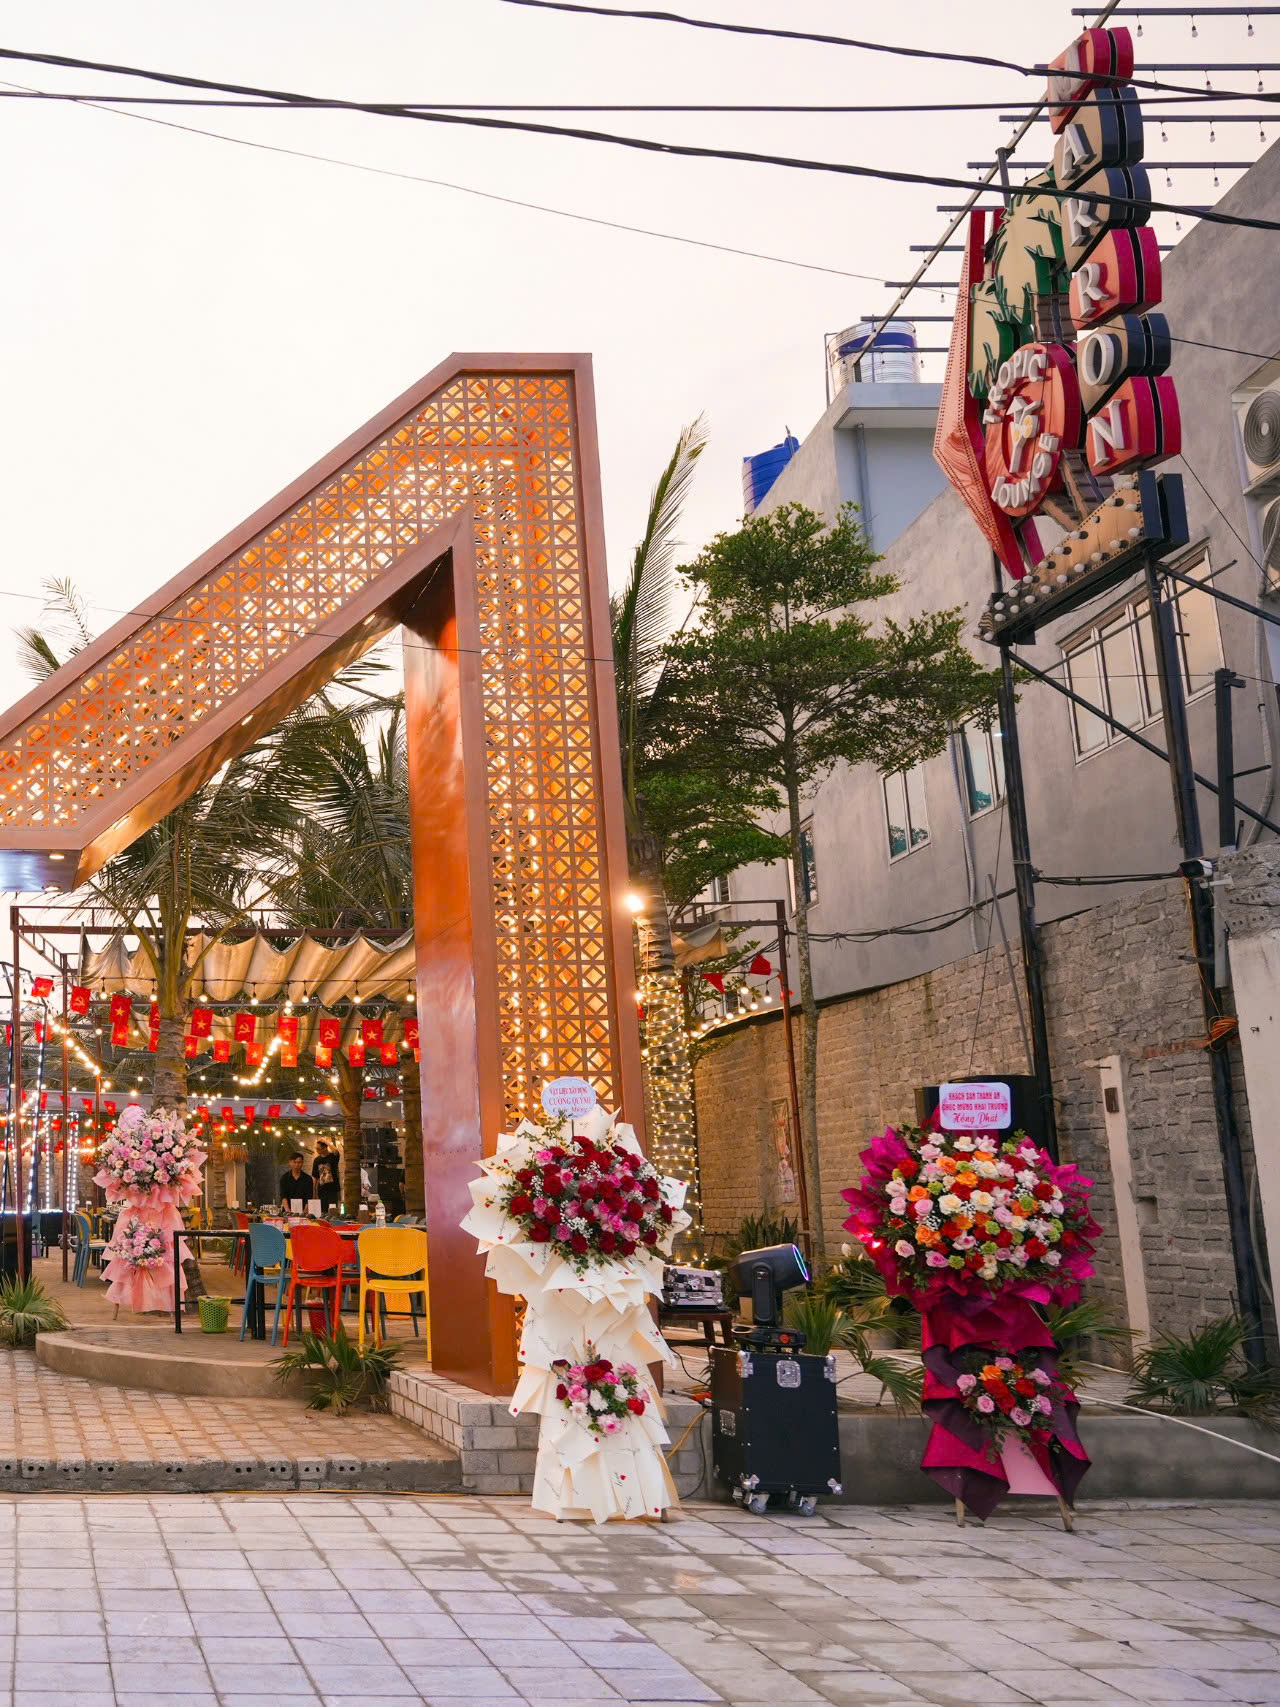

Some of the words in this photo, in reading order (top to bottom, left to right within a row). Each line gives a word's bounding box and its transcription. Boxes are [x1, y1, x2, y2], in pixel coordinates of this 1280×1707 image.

[1048, 38, 1127, 468] MARRON
[982, 349, 1049, 424] TROPIC
[990, 432, 1060, 508] LOUNGE
